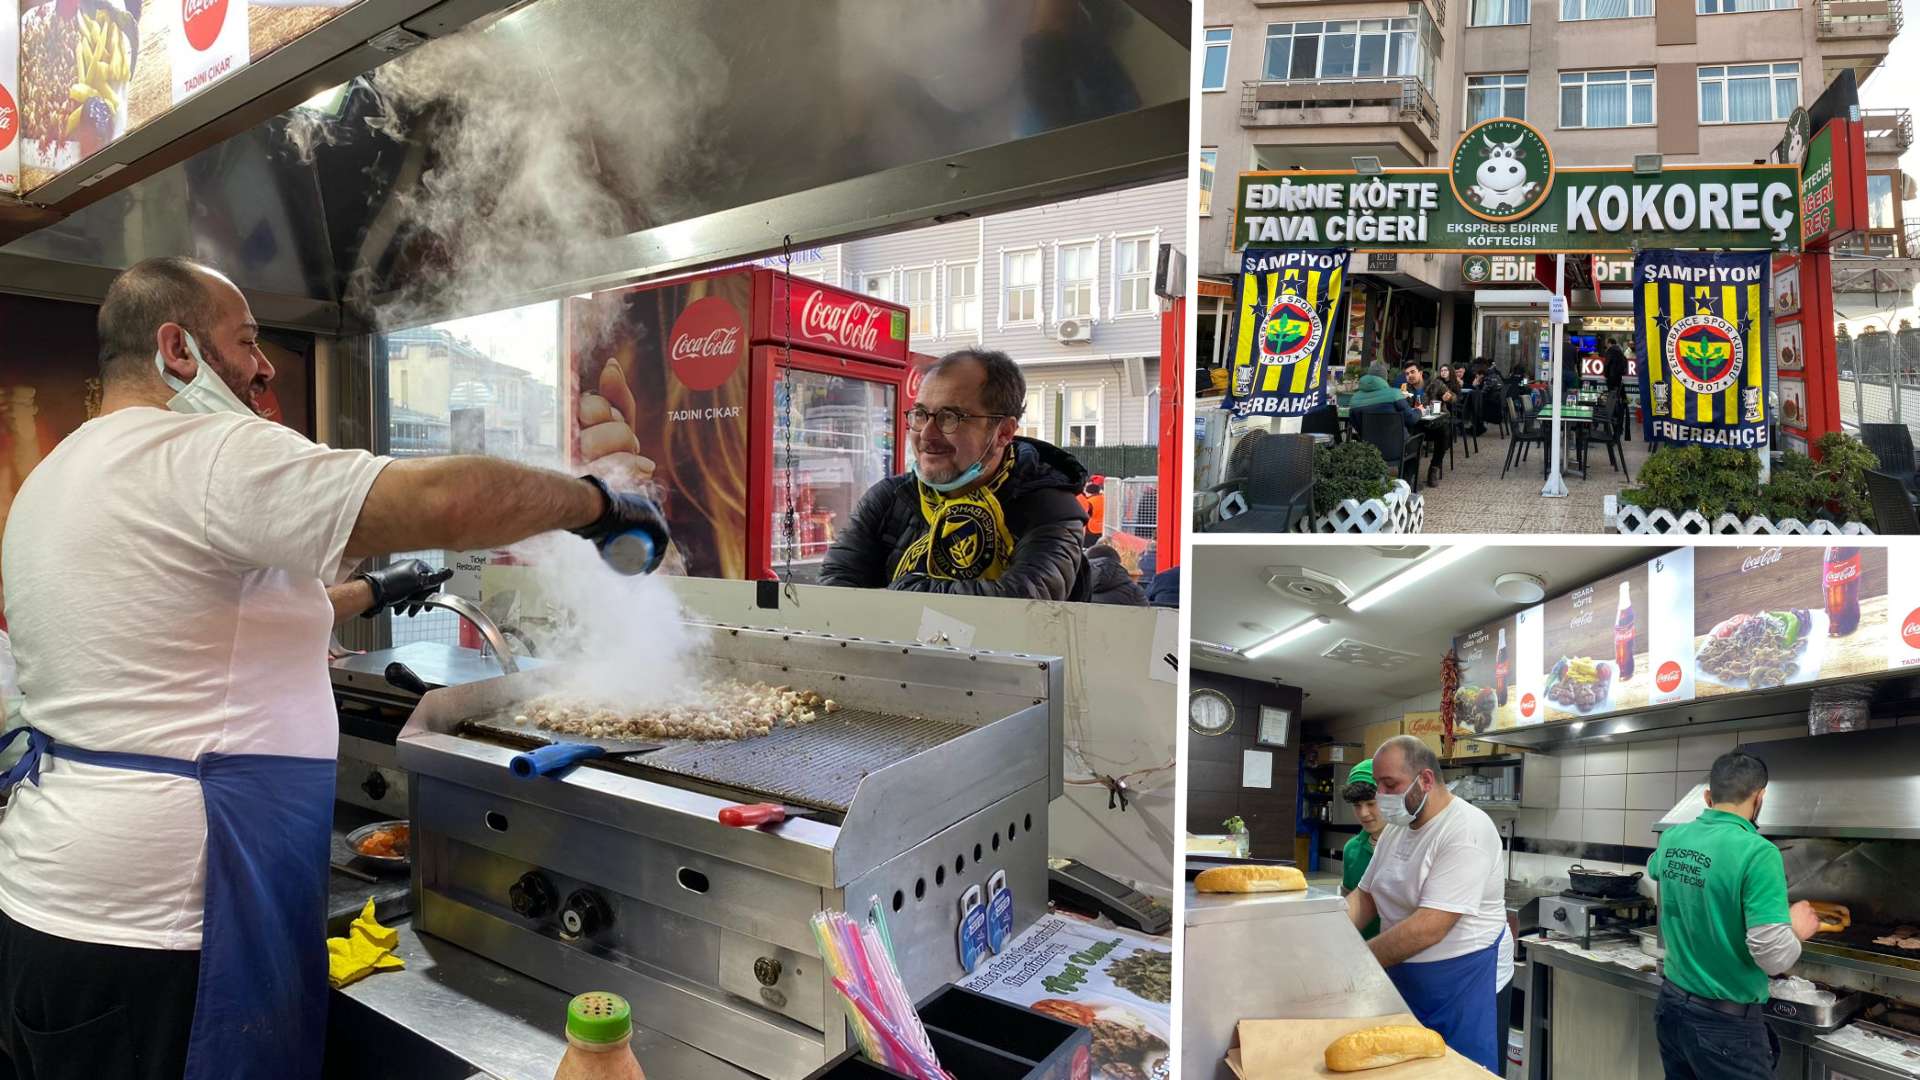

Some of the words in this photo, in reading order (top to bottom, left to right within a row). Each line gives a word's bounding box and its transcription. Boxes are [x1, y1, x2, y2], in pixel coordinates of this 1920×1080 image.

[184, 71, 207, 92] TADINI
[1802, 157, 1832, 193] FTECİSİ
[1245, 177, 1344, 212] EDİRNE
[1349, 176, 1439, 209] KÖFTE
[1566, 181, 1795, 242] KOKOREÇ
[1245, 215, 1320, 242] TAVA
[1325, 209, 1428, 242] CİĞERİ
[1447, 223, 1506, 233] EKSPRES
[1510, 222, 1558, 233] EDİRNE
[1467, 235, 1536, 246] KÖFTECİSİ
[1245, 250, 1347, 275] ŞAMPİYON
[1490, 256, 1536, 281] EDİR
[1596, 256, 1634, 281] ÖFT
[1644, 264, 1760, 282] ŞAMPİYON
[1288, 296, 1312, 313] SPOR
[801, 290, 881, 352] Coca-Cola
[1703, 316, 1733, 334] SPOR
[672, 326, 741, 360] Coca-Cola
[1263, 355, 1291, 364] 1907
[1690, 381, 1720, 392] 1907
[667, 408, 702, 422] TADINI
[705, 406, 740, 420] ÇIKAR
[1653, 421, 1767, 449] FENERBAHÇE
[1742, 548, 1783, 572] Coca-Cola
[1825, 563, 1857, 582] Coca-Cola
[1665, 848, 1712, 869] EKSPRES
[1668, 860, 1702, 876] EDİRNE
